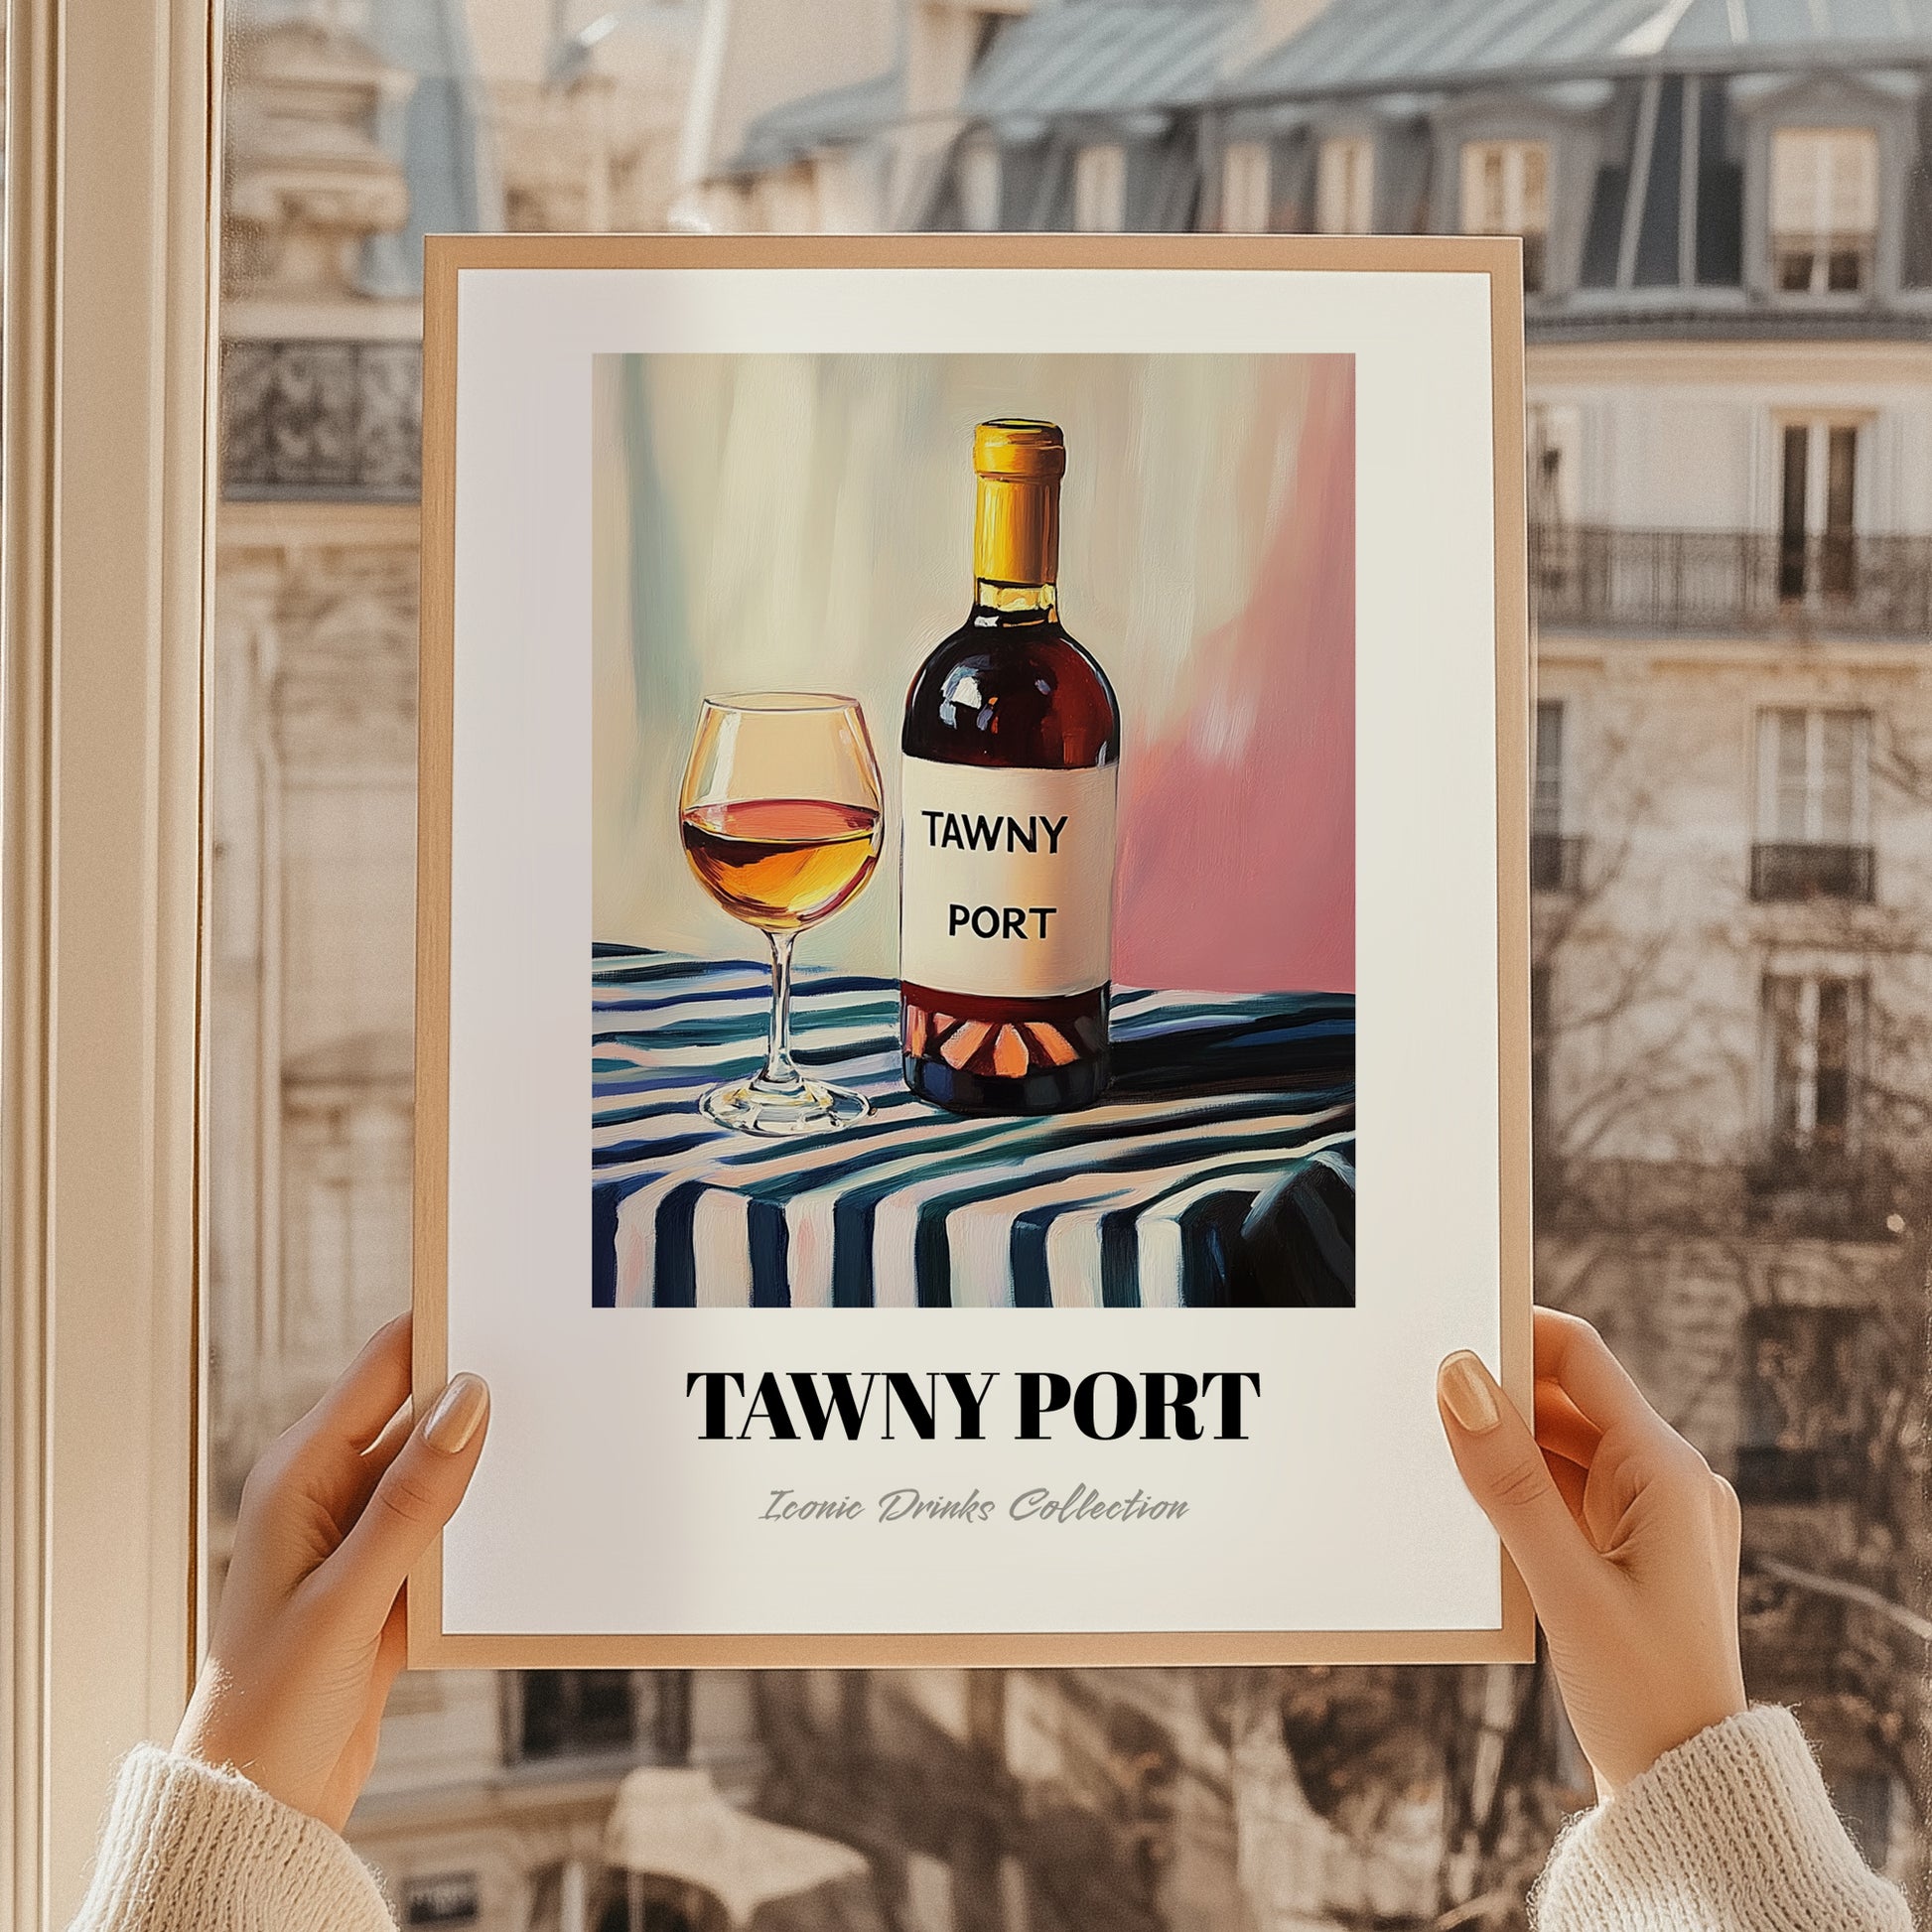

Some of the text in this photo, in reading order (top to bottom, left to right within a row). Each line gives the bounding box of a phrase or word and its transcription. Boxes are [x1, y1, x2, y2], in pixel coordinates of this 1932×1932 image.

[921, 810, 1069, 855] TAWNY
[949, 904, 1057, 940] PORT
[686, 1371, 1261, 1442] TAWNY PORT
[758, 1482, 1190, 1523] Iconic Drinks Collection
